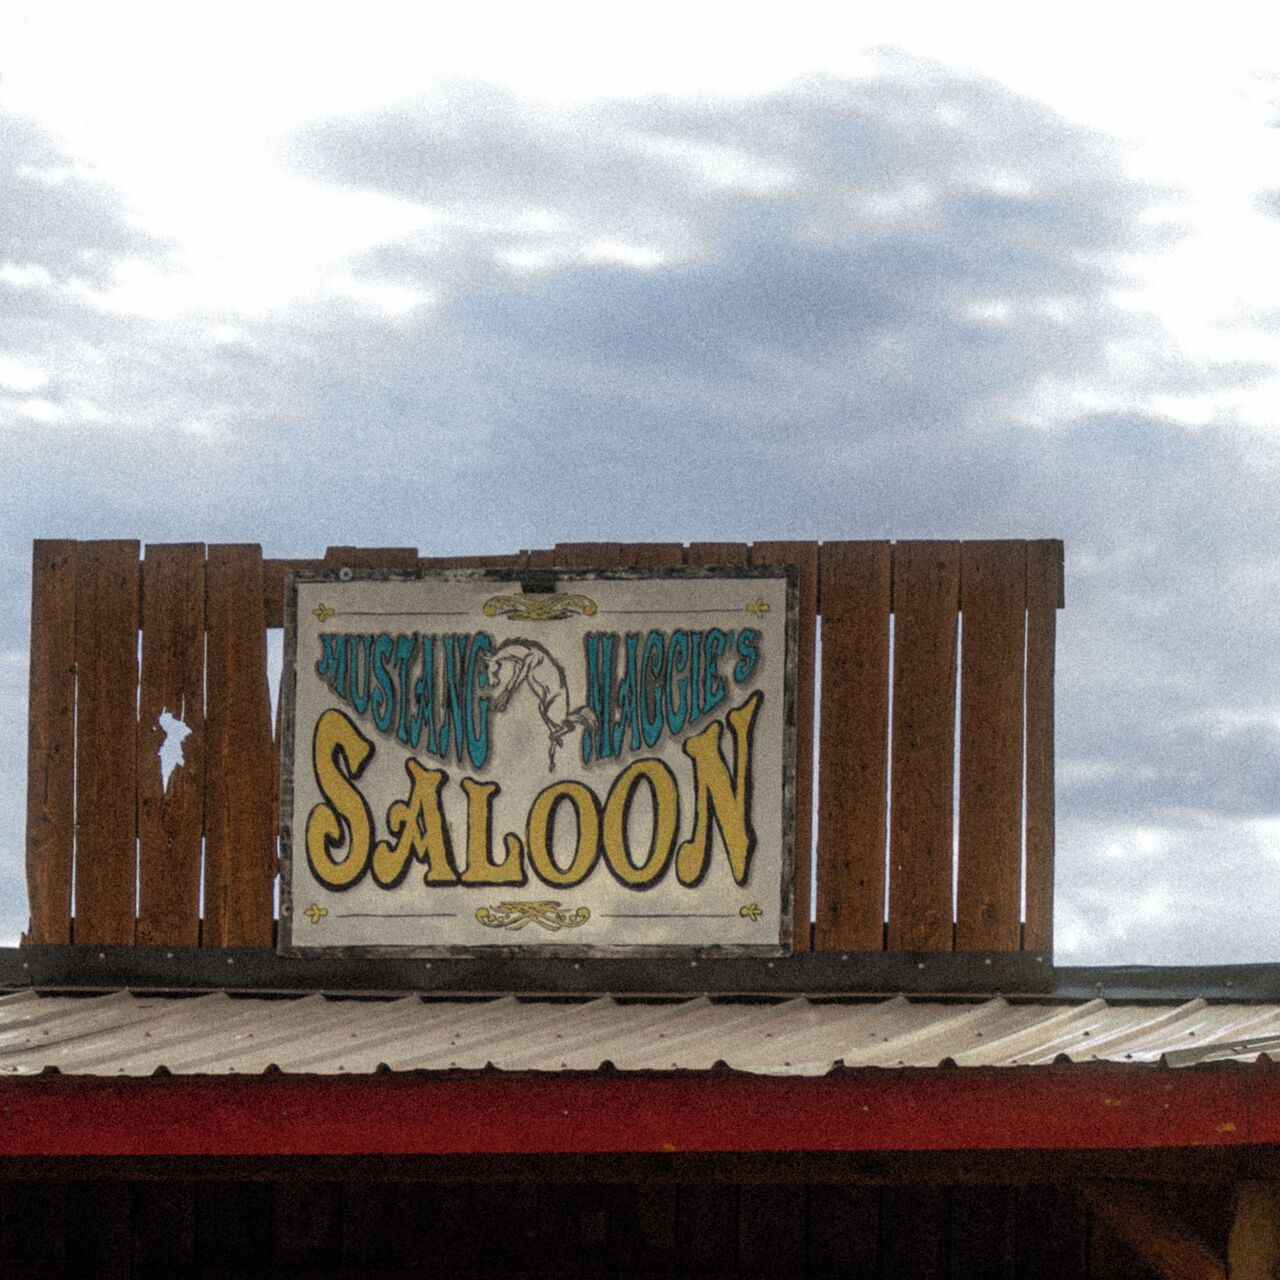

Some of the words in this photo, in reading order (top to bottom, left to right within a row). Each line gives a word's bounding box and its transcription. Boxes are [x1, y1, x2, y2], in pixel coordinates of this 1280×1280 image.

[316, 631, 494, 769] MUSTANG
[581, 627, 761, 766] MAGGIE'S
[305, 690, 765, 892] SALOON
